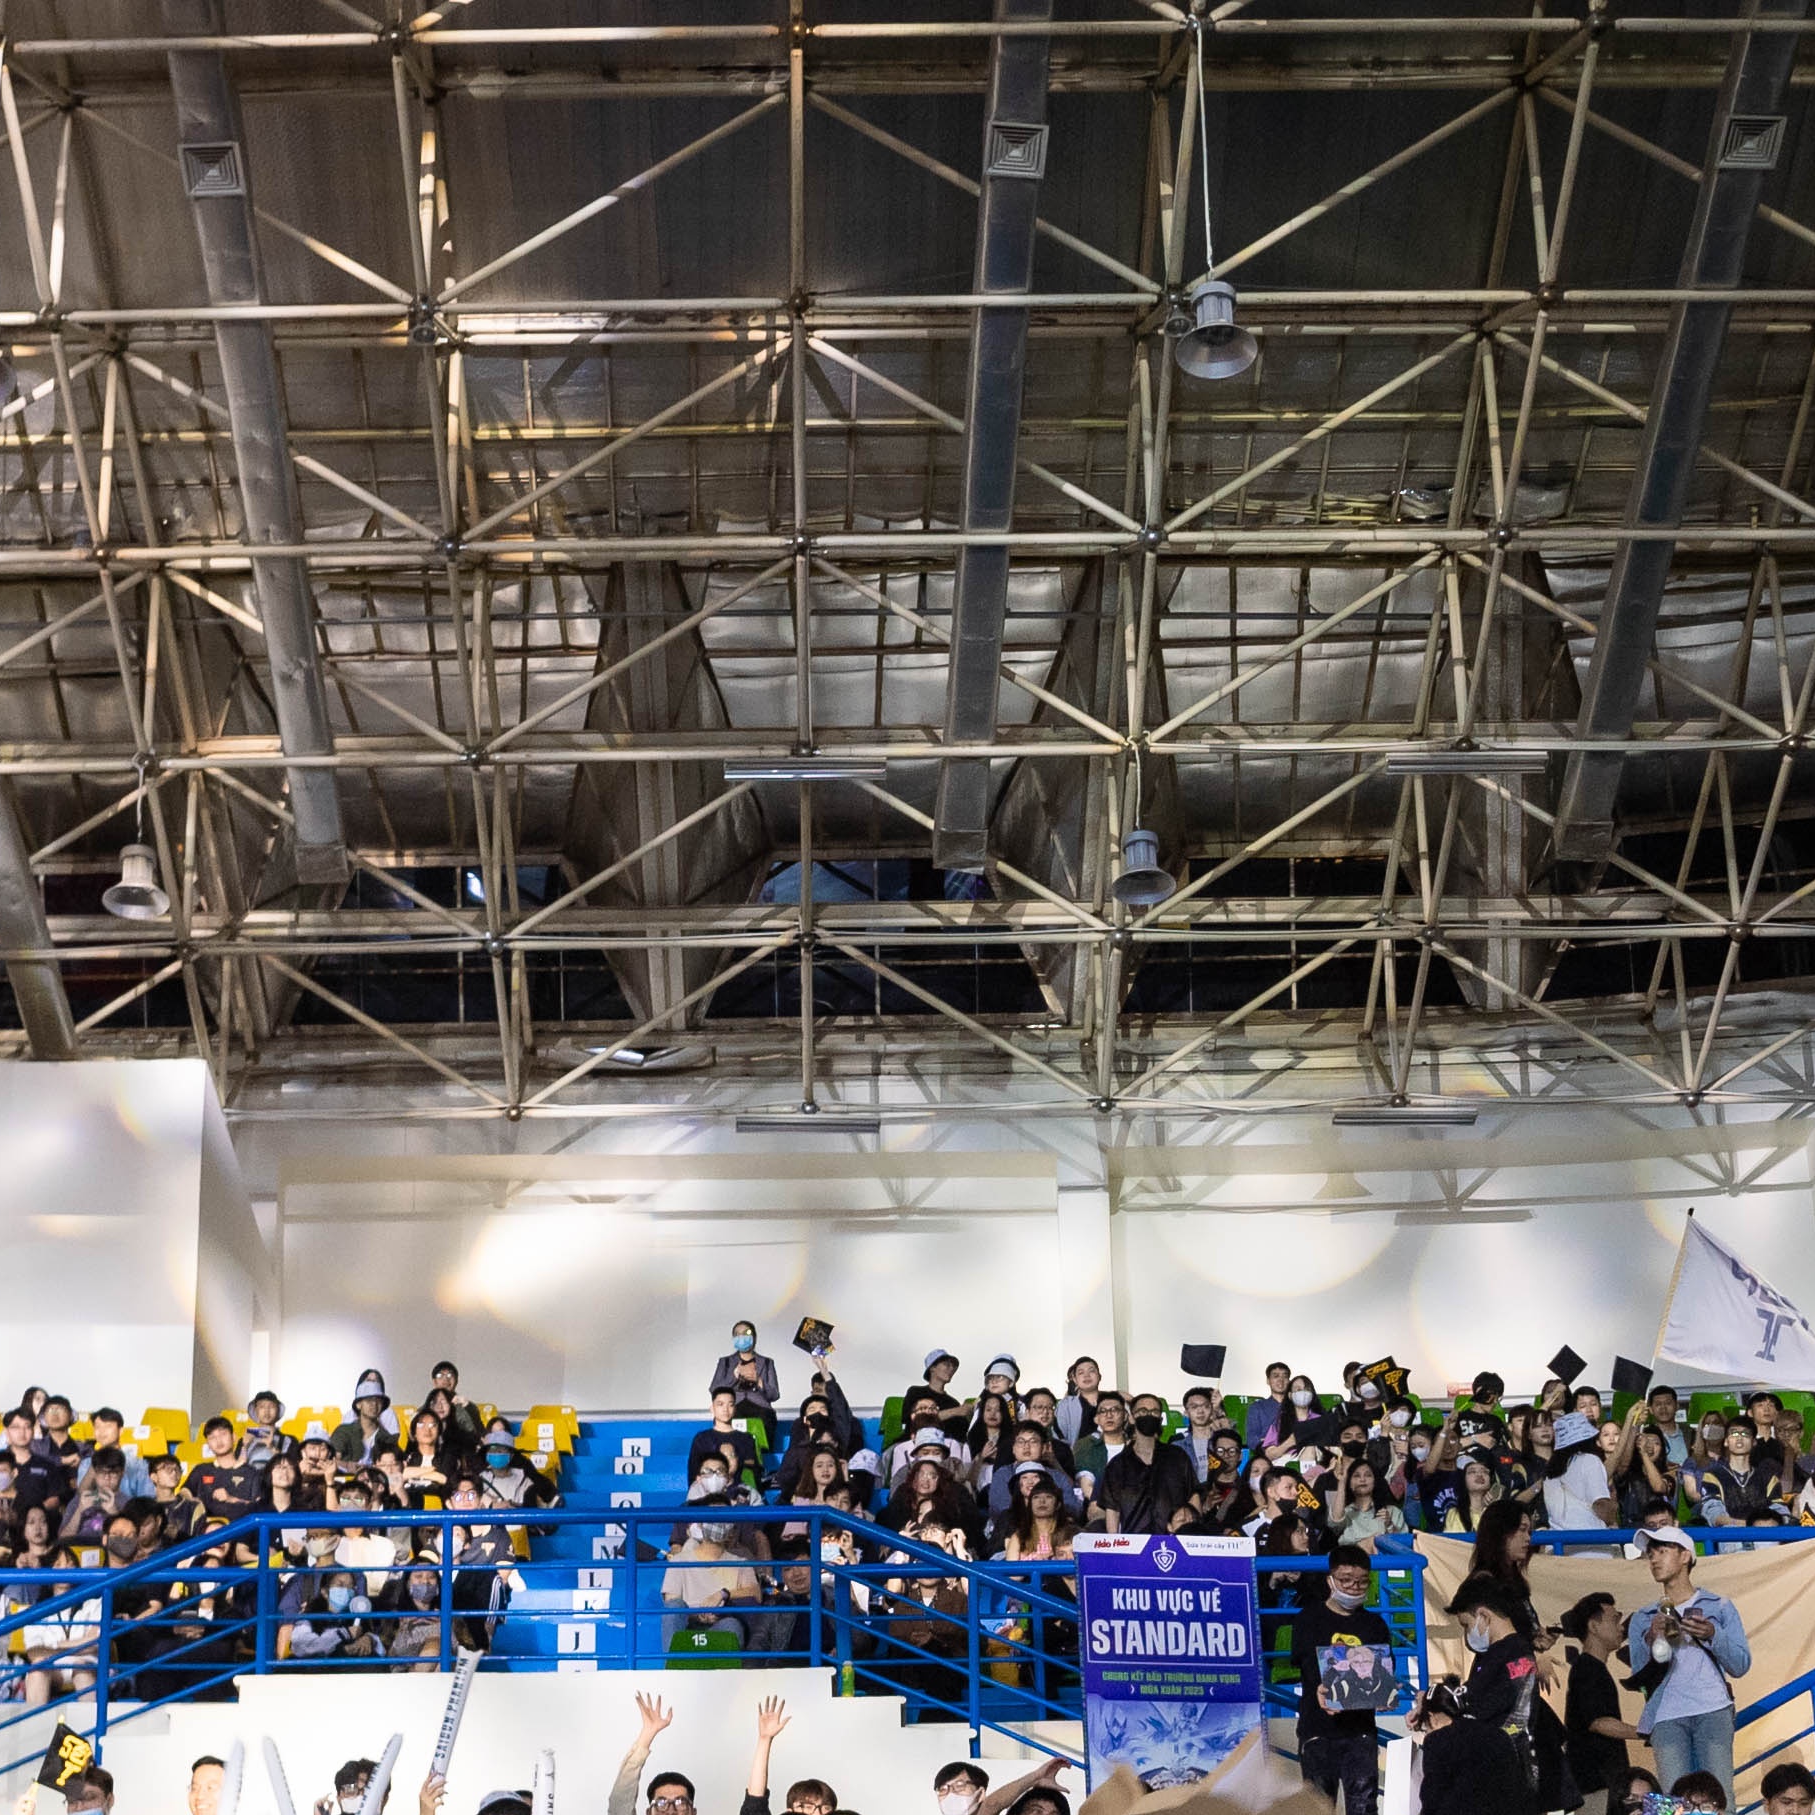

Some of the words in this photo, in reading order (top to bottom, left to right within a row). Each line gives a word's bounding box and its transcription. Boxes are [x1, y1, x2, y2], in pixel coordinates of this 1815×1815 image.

[589, 1571, 601, 1588] L
[1112, 1588, 1151, 1611] KHU
[1156, 1587, 1194, 1615] VỰC
[1199, 1587, 1222, 1613] VÉ
[691, 1633, 708, 1646] 15
[1091, 1618, 1246, 1657] STANDARD
